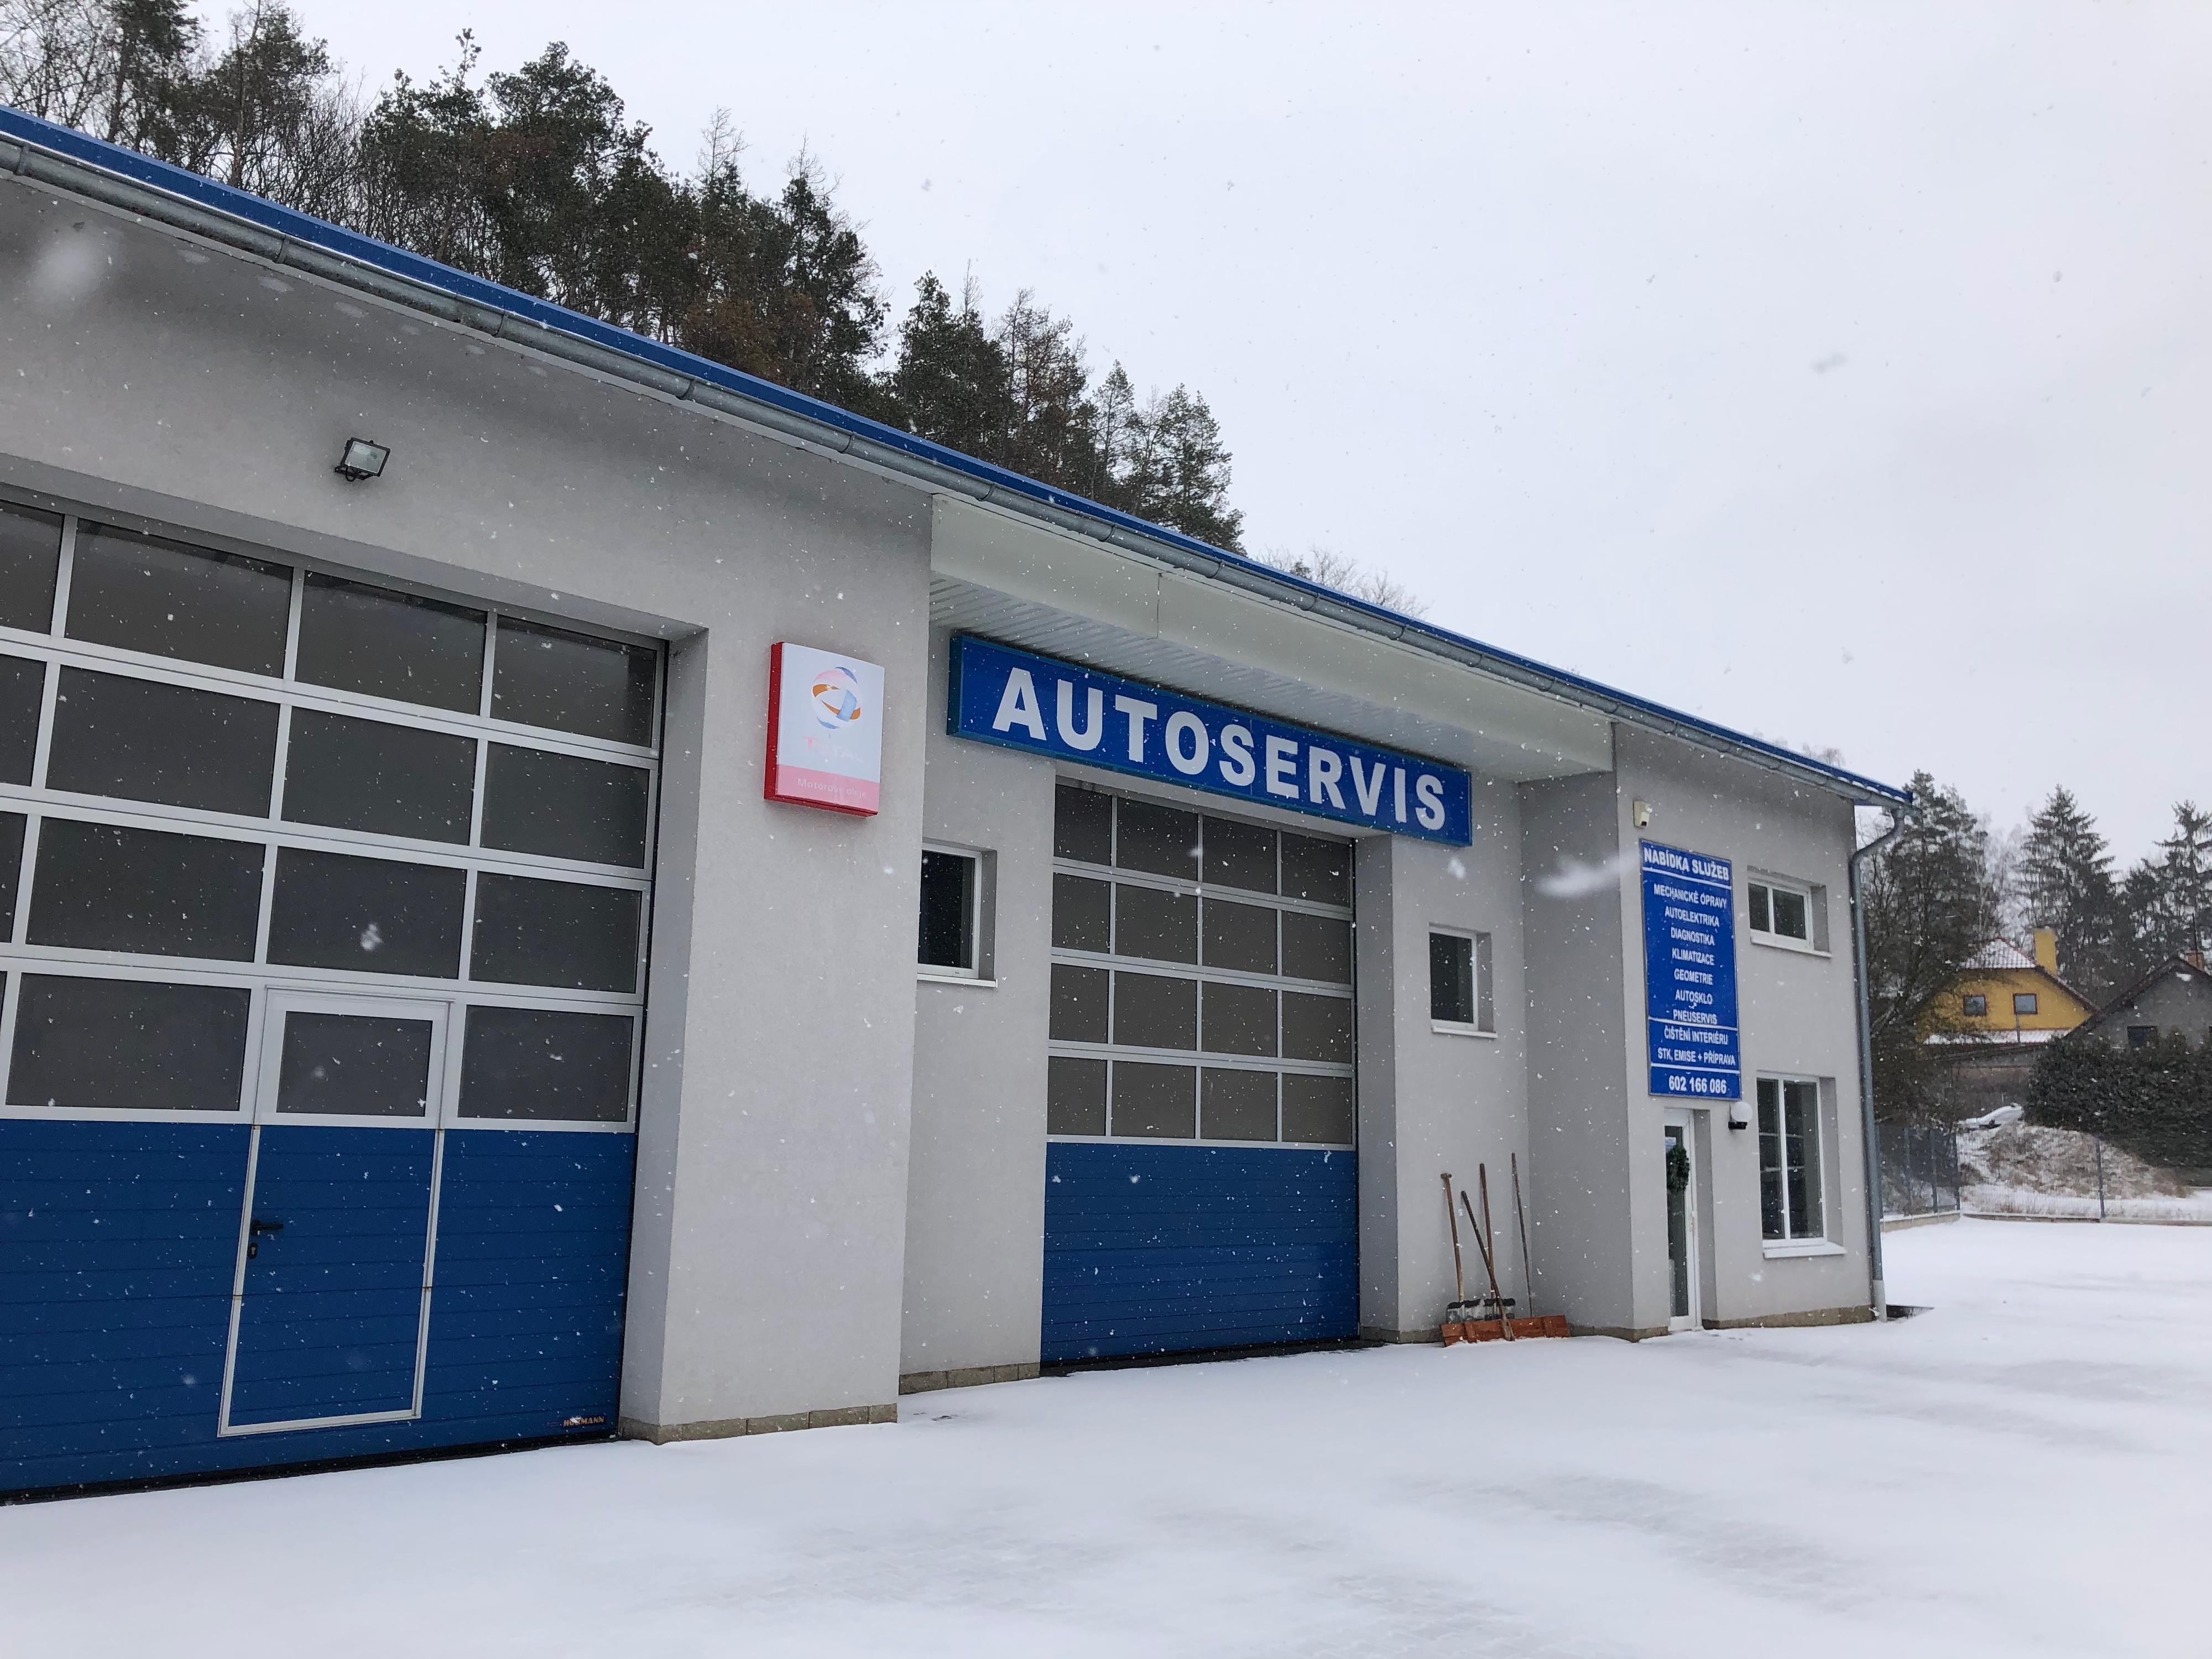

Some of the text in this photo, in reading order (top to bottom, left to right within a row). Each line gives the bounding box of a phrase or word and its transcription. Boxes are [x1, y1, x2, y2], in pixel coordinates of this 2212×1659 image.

[804, 735, 866, 763] TTA
[993, 667, 1445, 831] AUTOSERVIS
[1644, 847, 1729, 881] NABÍDKA SLUŽEB
[1653, 883, 1727, 909] MECHANICKÉ OPRAVY
[1665, 906, 1720, 928] AUTOELEKTRIKA
[1671, 926, 1715, 946] DIAGNOSTIKA
[1672, 947, 1715, 966] KLIMATIZACE
[1674, 968, 1714, 985] GEOMETRIE
[1675, 989, 1713, 1005] AUTOSKLO
[1673, 1009, 1718, 1025] PNEUSERVIS
[1664, 1025, 1729, 1045] ČIŠTĚNÍ INTERIÉRU
[1657, 1047, 1673, 1062] STK,
[1674, 1049, 1697, 1063] EMISE
[1703, 1050, 1736, 1066] PŘÍPRAVA
[1668, 1074, 1727, 1094] 602 166 086
[564, 1416, 604, 1427] HMANN
